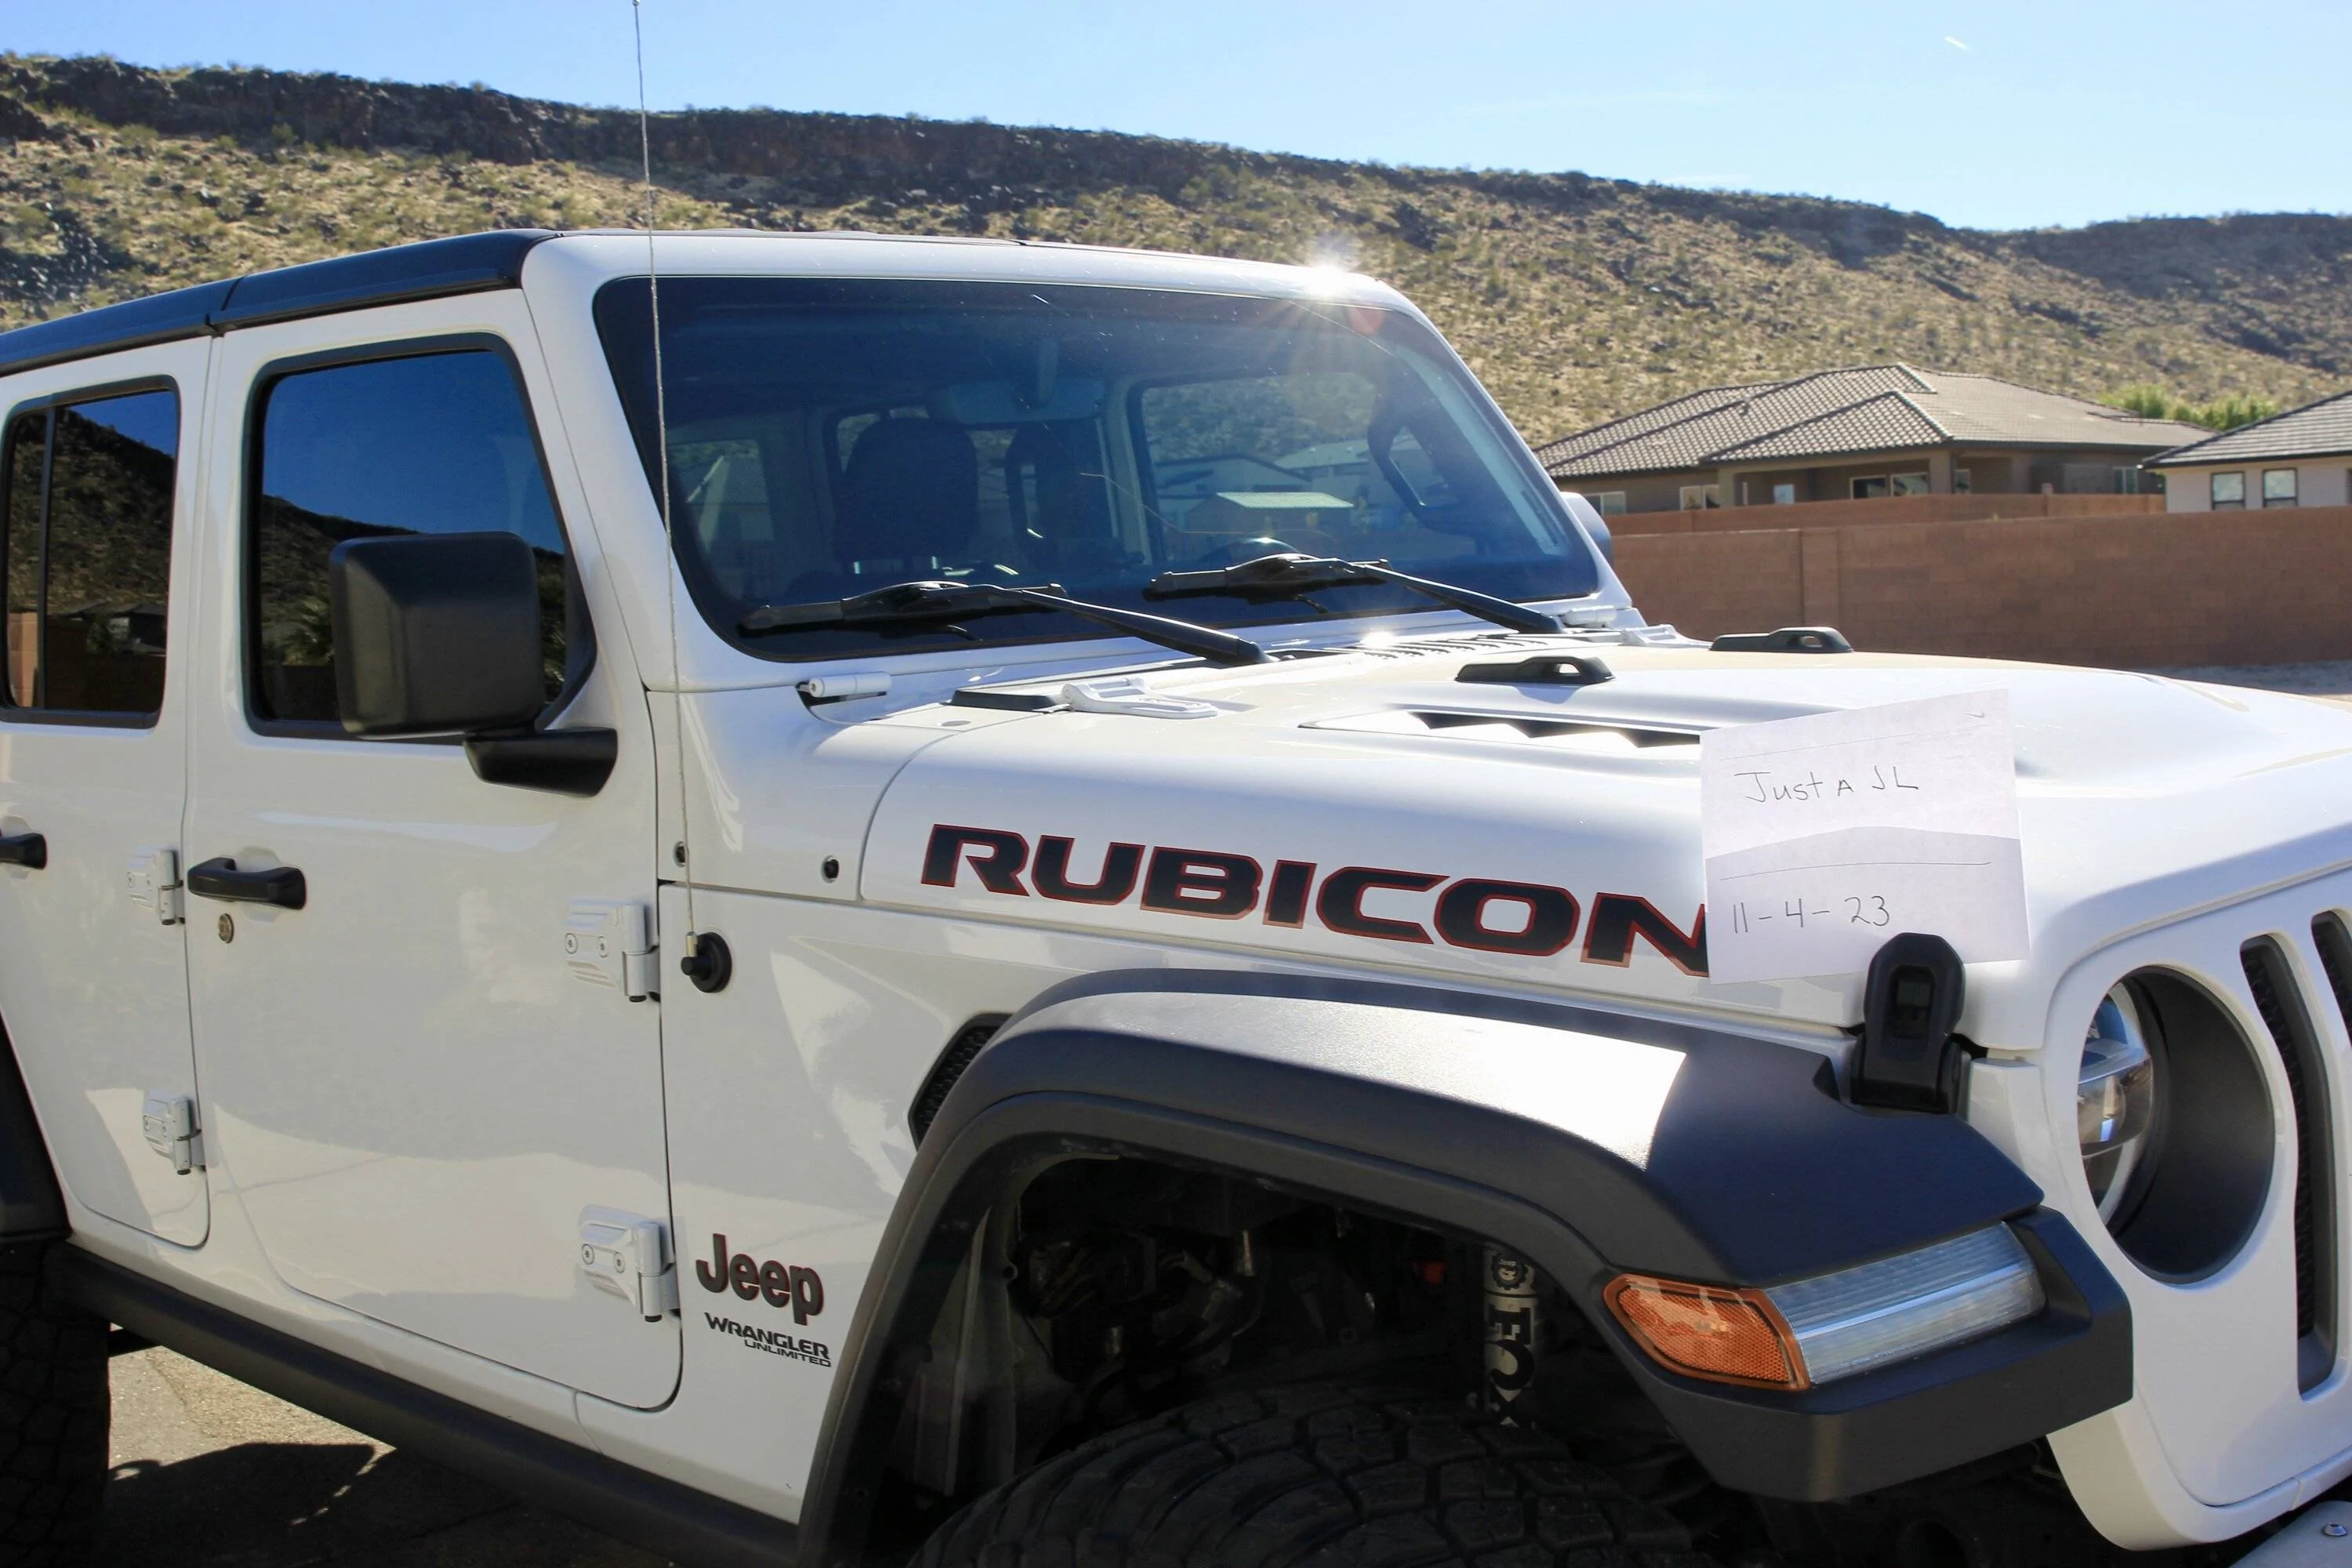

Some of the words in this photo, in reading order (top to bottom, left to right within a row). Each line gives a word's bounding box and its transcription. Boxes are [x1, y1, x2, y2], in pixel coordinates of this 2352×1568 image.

[1733, 771, 1824, 803] Just
[1871, 765, 1919, 791] JL
[920, 823, 1708, 978] RUBICON
[695, 1232, 825, 1326] Jeep
[704, 1312, 831, 1360] WRANGLER
[744, 1338, 832, 1368] UNLIMITED
